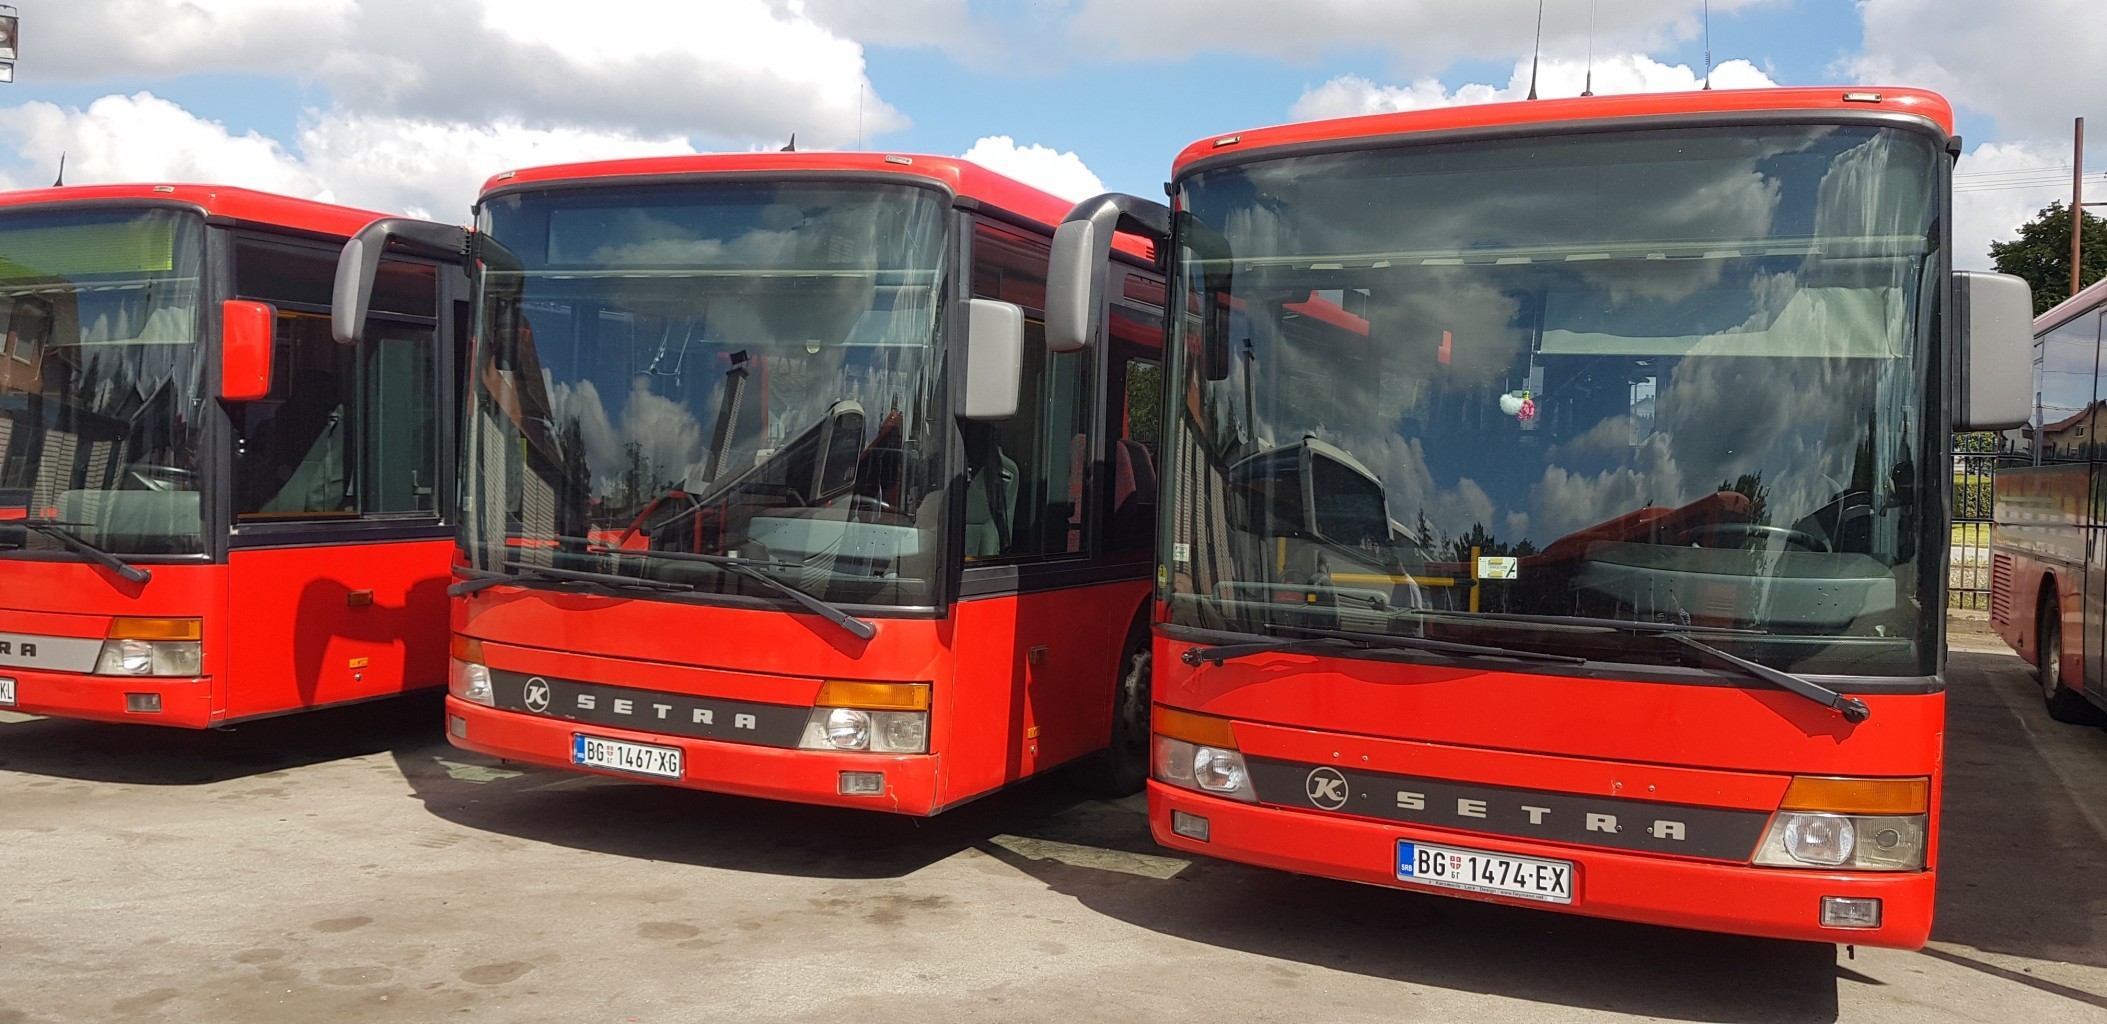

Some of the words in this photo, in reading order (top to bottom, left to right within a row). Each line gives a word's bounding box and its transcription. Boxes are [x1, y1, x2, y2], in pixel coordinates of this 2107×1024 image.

[577, 694, 756, 729] SETRA
[587, 741, 604, 761] BG
[1397, 791, 1686, 841] SETRA
[1401, 863, 1412, 872] SRB
[1418, 849, 1446, 876] BG
